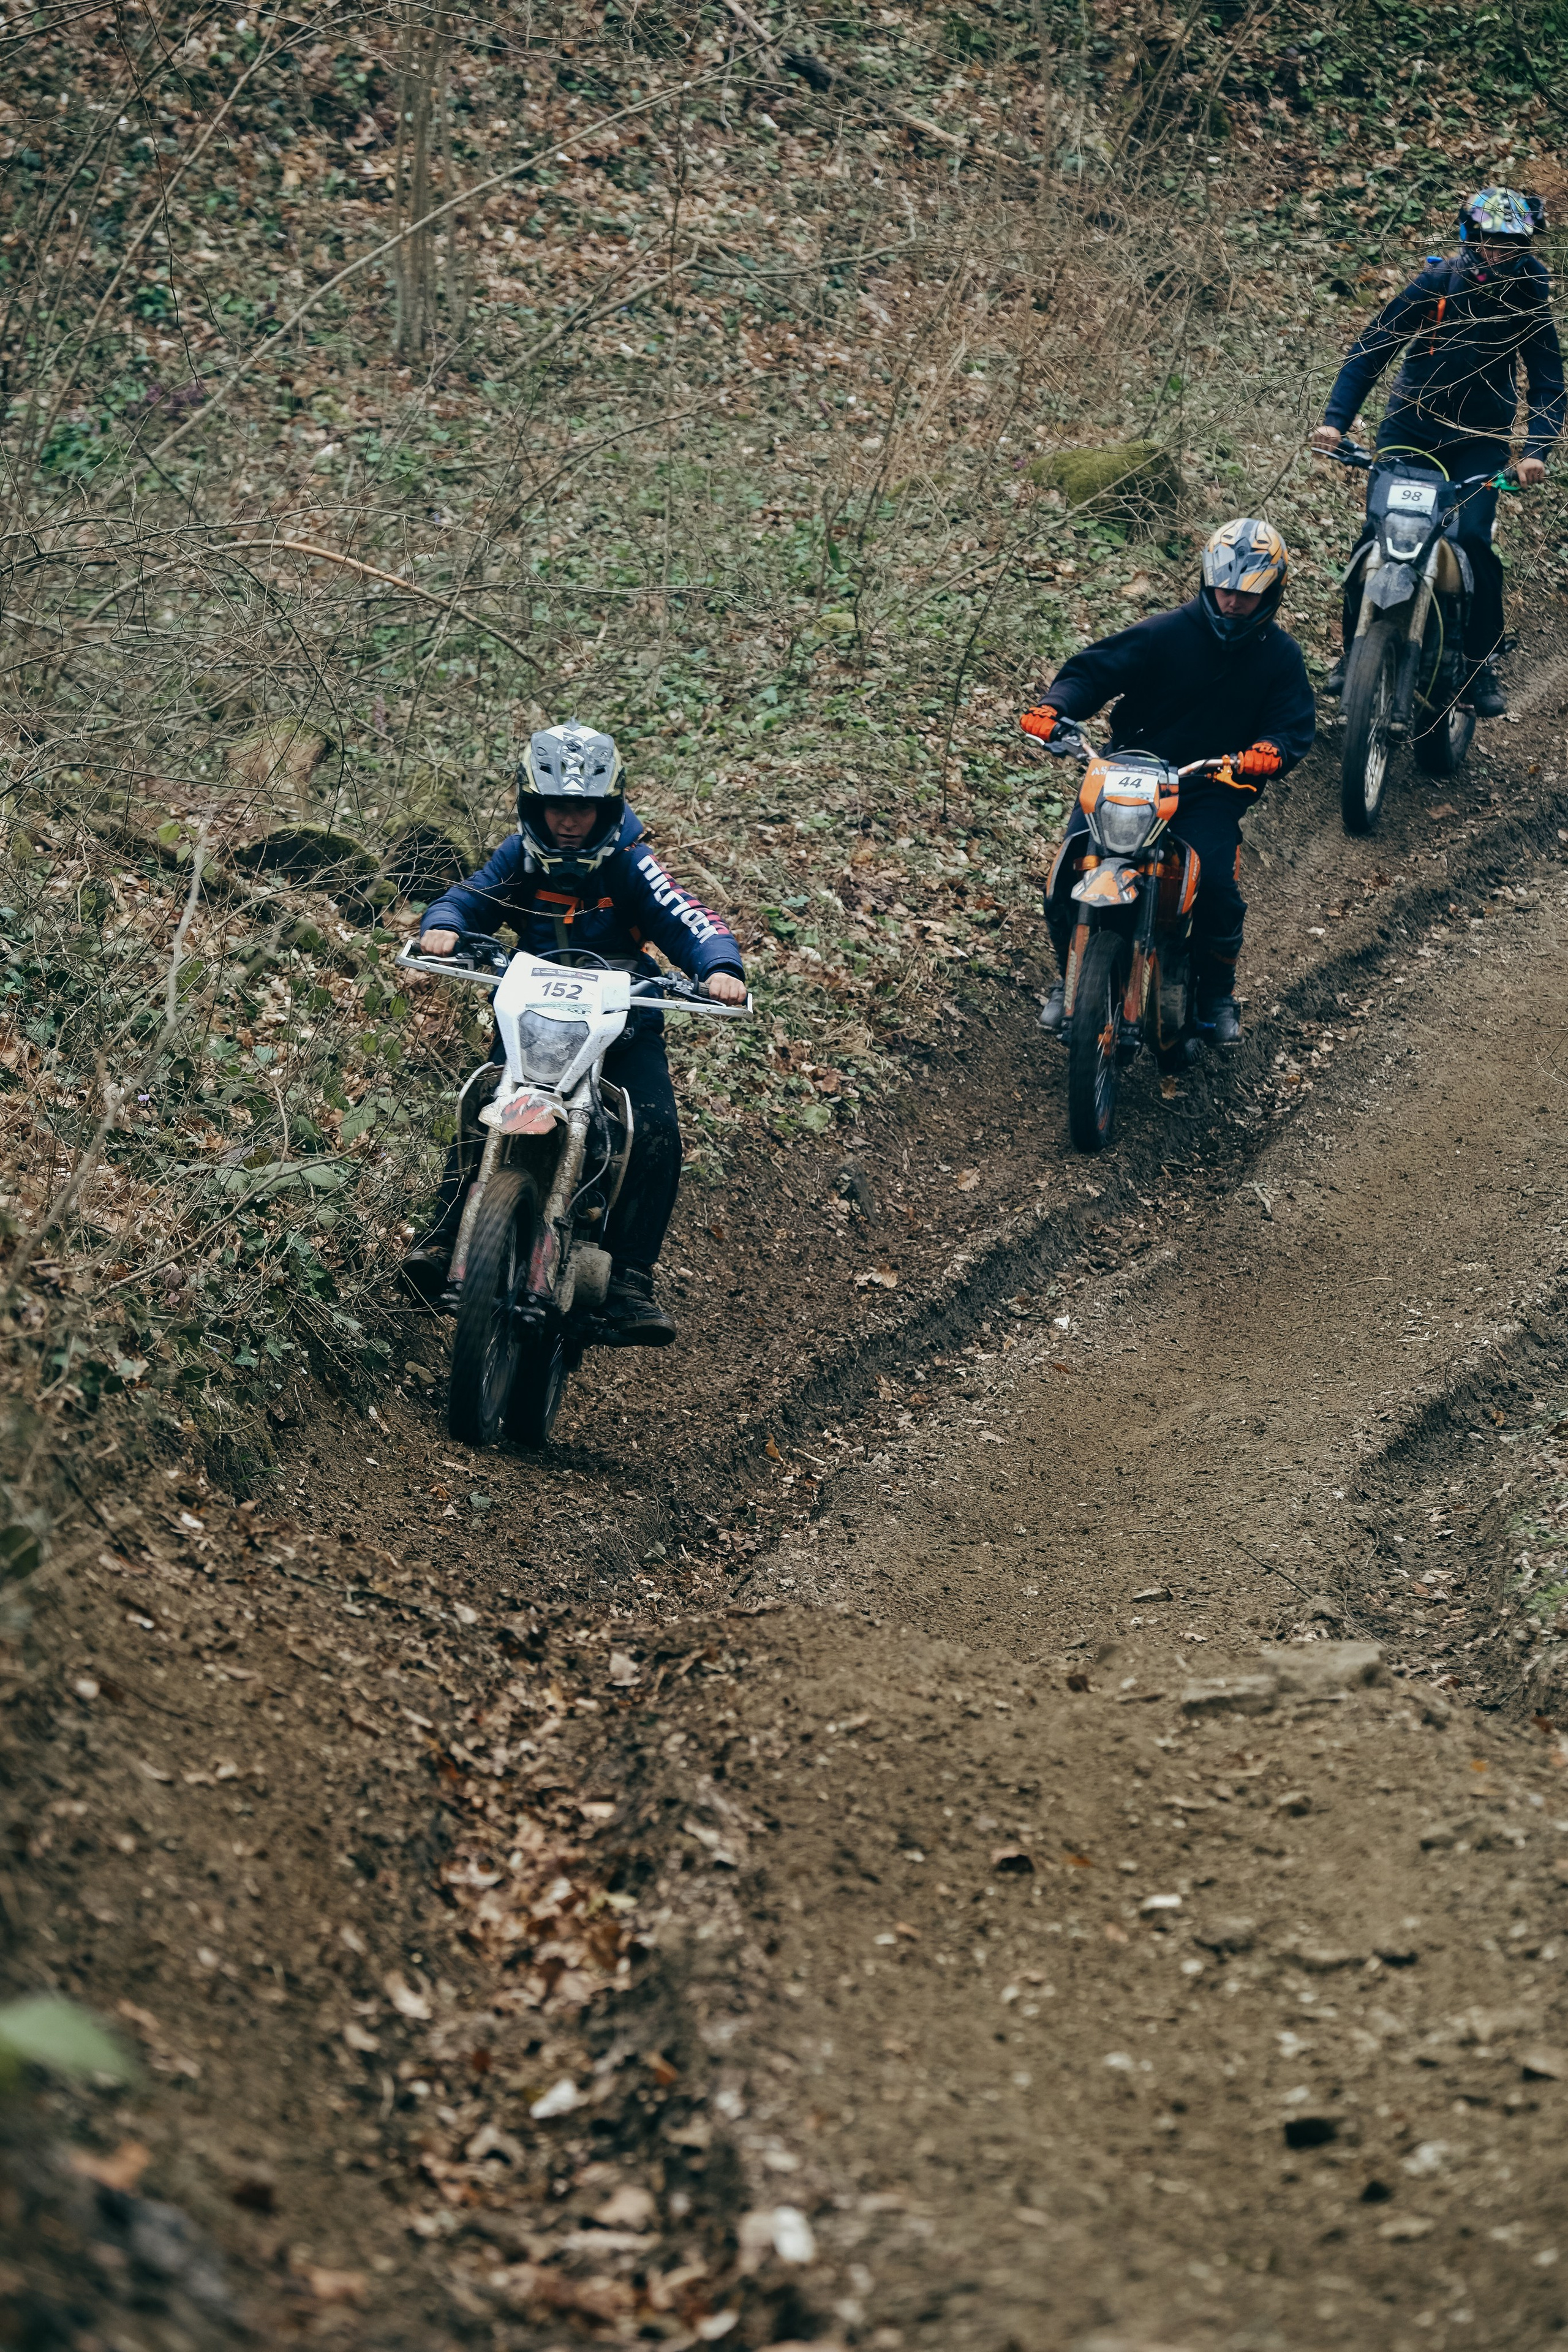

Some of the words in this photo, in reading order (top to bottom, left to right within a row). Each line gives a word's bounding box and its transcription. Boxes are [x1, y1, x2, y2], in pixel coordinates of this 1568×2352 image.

[1401, 491, 1422, 502] 98
[1118, 777, 1142, 788] 44
[541, 981, 582, 1000] 152
